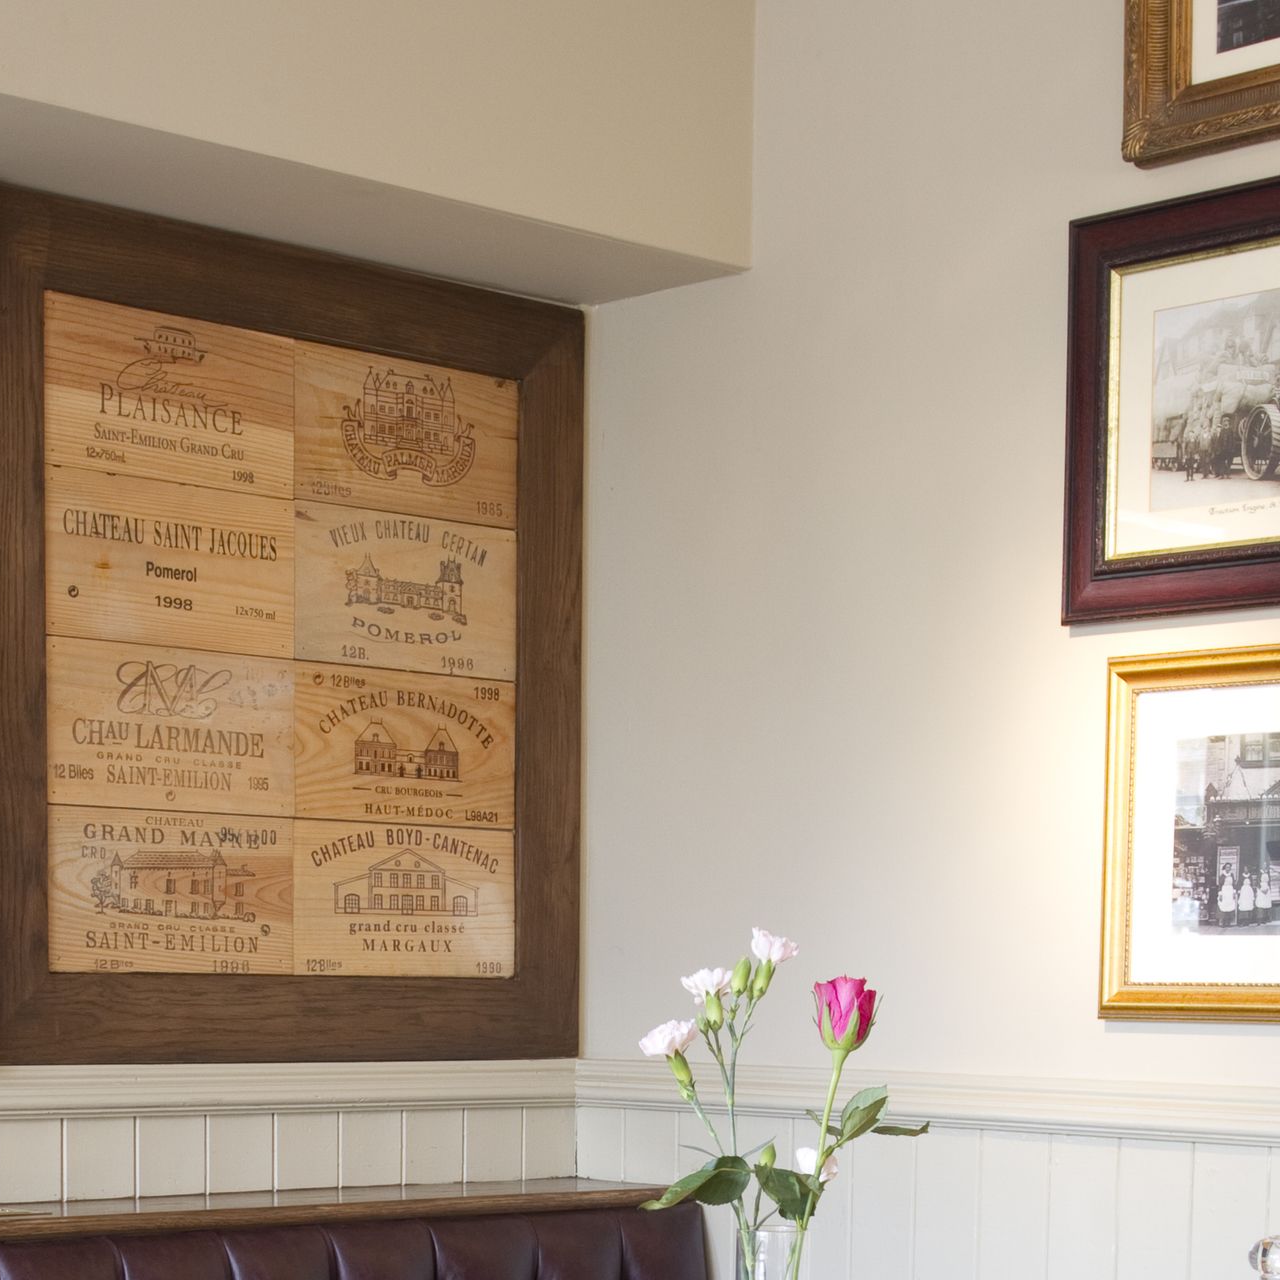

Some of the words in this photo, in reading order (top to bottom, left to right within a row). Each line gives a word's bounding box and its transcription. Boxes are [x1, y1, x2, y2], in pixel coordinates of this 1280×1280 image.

[99, 383, 243, 436] PLAISANCE
[180, 437, 218, 457] GRAND
[221, 444, 244, 461] CRU
[343, 424, 382, 475] CHATEAU
[385, 453, 435, 475] PALMER
[436, 441, 474, 483] MARGAUX
[232, 470, 254, 483] 1998
[63, 509, 145, 544] CHATEAU
[153, 521, 202, 551] SAINT
[209, 528, 277, 561] JACQUES
[329, 521, 367, 548] VIEUX
[375, 519, 430, 543] CHATEAU
[442, 531, 488, 567] CERTAN
[146, 561, 197, 582] Pomerol
[155, 595, 193, 611] 1998
[235, 606, 263, 618] 12x750
[265, 611, 276, 620] ml
[352, 616, 462, 645] POMEROL
[474, 686, 500, 701] 1998
[319, 690, 389, 735] CHATEAU
[397, 690, 495, 750] BERNADOTTE
[135, 724, 264, 759] LARMANDE
[97, 751, 143, 763] GRAND
[156, 756, 181, 765] CRU
[106, 764, 232, 792] SAINT-EMILION
[375, 785, 393, 795] CRU
[394, 787, 443, 799] BOURGEOIS
[364, 803, 455, 819] HAUT-MÉDOC
[465, 810, 499, 823] L98A21
[145, 816, 205, 828] CHATEAU
[83, 823, 165, 845] GRAND
[310, 831, 375, 868] CHATEAU
[109, 922, 150, 931] GRAND
[157, 924, 180, 932] CRU
[349, 920, 391, 935] grand
[395, 923, 418, 933] cru
[86, 930, 260, 954] SAINT-EMILION
[362, 938, 453, 952] MARGAUX
